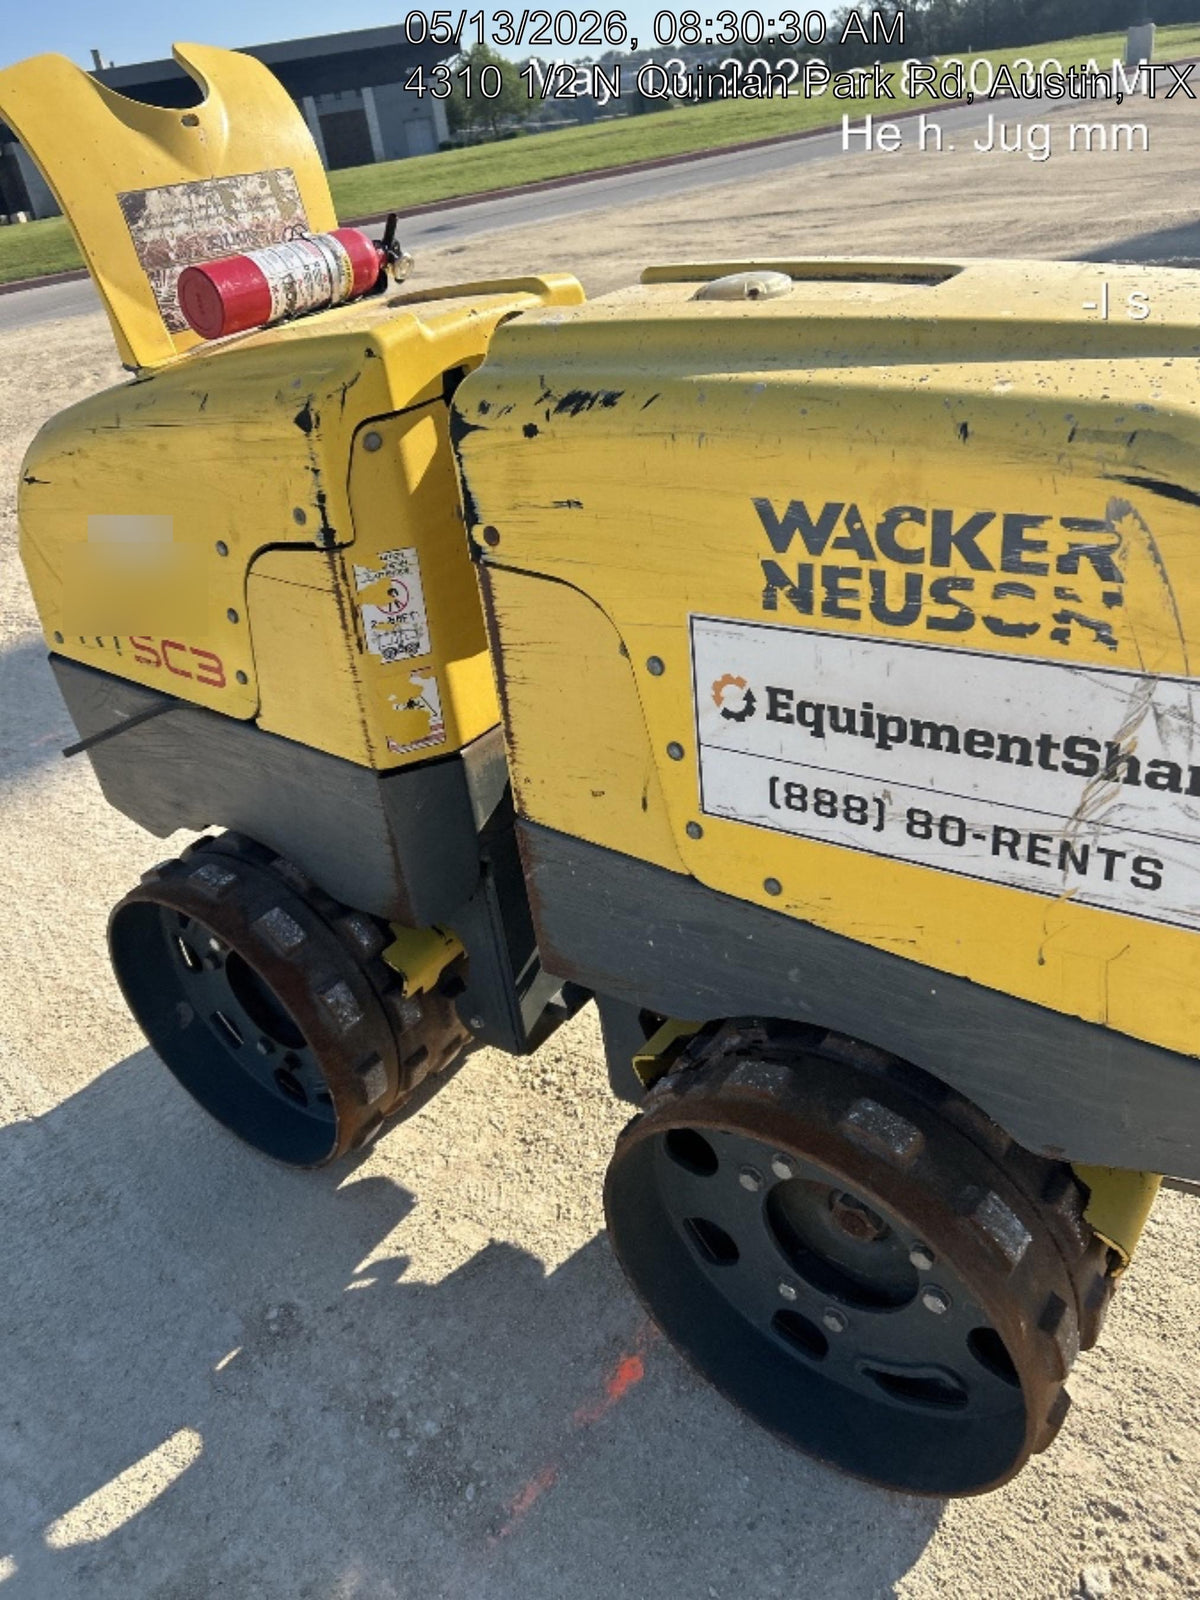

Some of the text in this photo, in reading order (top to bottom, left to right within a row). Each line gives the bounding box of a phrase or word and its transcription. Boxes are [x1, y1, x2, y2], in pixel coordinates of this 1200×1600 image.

[751, 498, 1124, 583] WACKER
[769, 776, 1164, 891] (888) 80-RENTS
